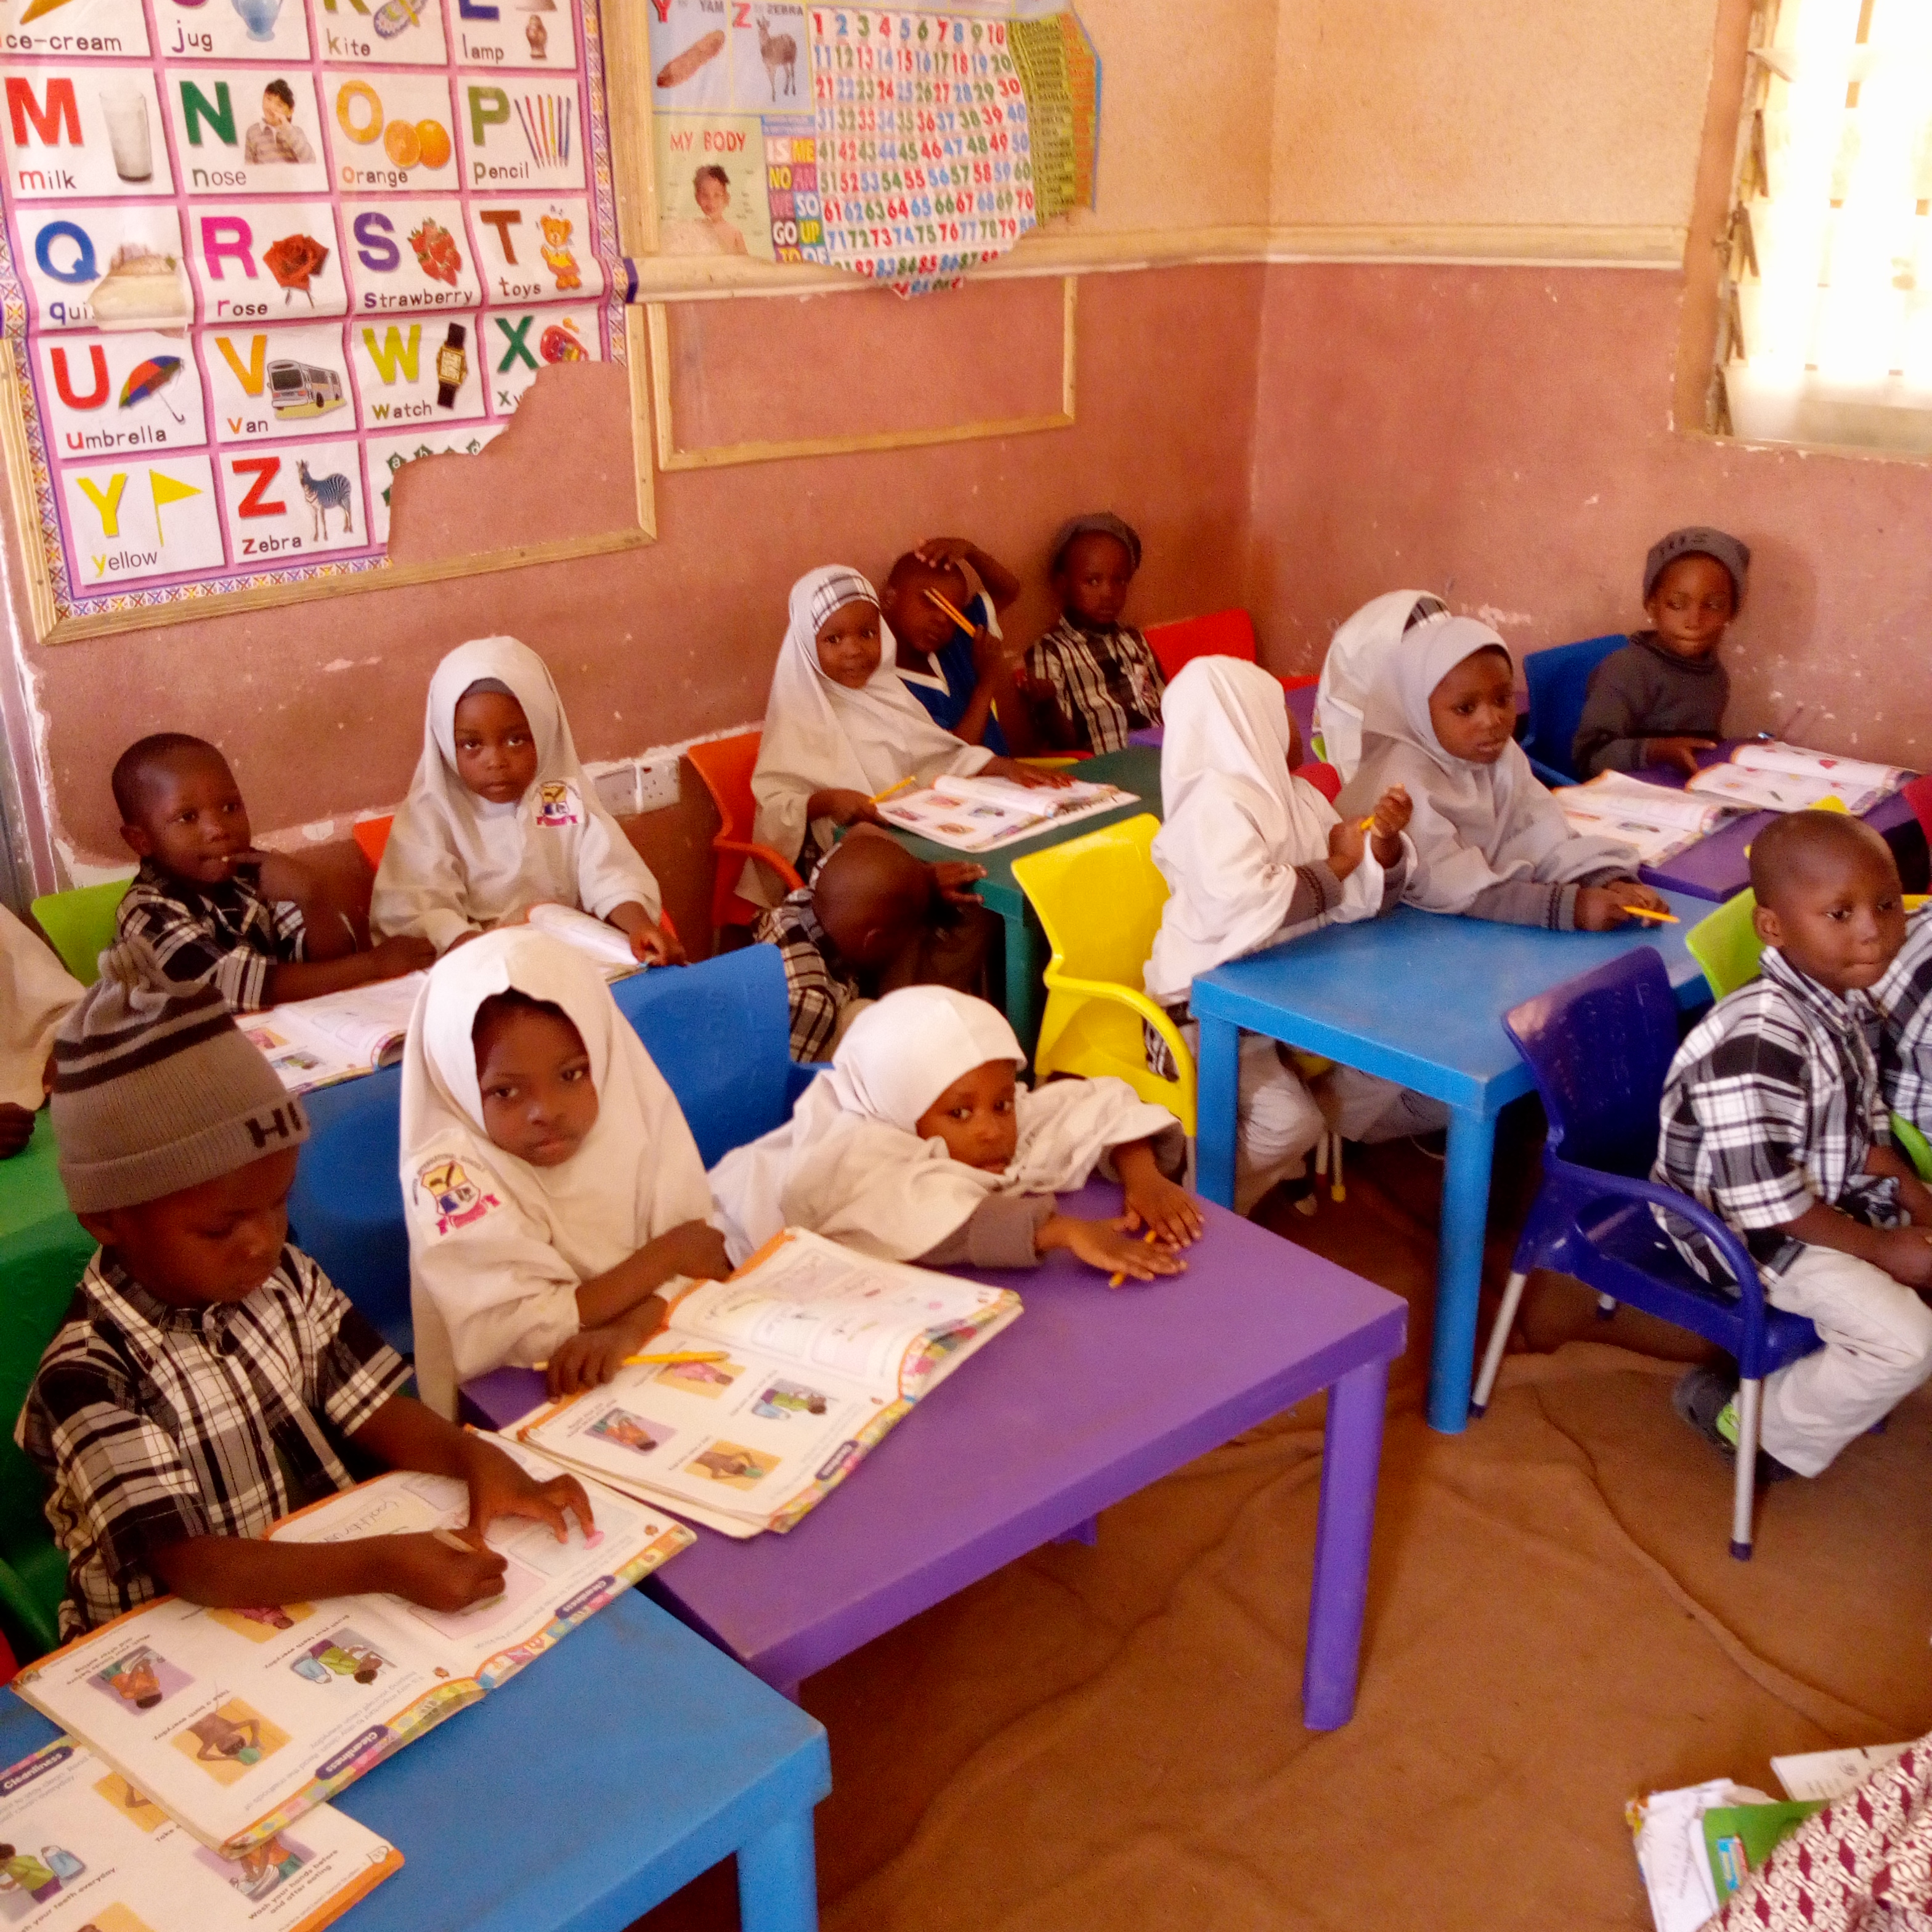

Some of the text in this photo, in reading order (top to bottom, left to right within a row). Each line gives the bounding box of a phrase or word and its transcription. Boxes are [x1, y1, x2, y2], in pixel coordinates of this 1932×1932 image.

[733, 2, 752, 28] Z
[813, 12, 822, 35] 1
[835, 14, 848, 36] 2
[858, 14, 870, 37] 3
[879, 16, 891, 38] 4
[917, 20, 928, 41] 6
[938, 18, 948, 43] 7
[971, 22, 983, 44] 9
[988, 24, 1004, 45] 10
[171, 20, 213, 53] jug
[326, 28, 371, 56] kite
[462, 34, 504, 63] lamp
[815, 45, 831, 68] 11
[835, 45, 853, 69] 12
[858, 46, 873, 70] 13
[897, 49, 912, 73] 15
[934, 51, 949, 74] 17
[953, 52, 968, 75] 18
[991, 54, 1012, 74] 20
[816, 76, 833, 100] 21
[878, 79, 893, 100] 24
[934, 81, 949, 103] 27
[973, 81, 994, 101] 29
[998, 78, 1021, 97] 30
[5, 77, 84, 146] M
[179, 80, 238, 145] N
[336, 80, 384, 145] O
[468, 86, 511, 147] P
[838, 108, 855, 131] 32
[859, 108, 875, 131] 33
[918, 110, 935, 132] 36
[938, 112, 954, 131] 37
[981, 105, 1003, 126] 39
[1008, 103, 1026, 123] 40
[670, 130, 747, 152] MY BODY
[819, 140, 835, 161] 41
[839, 140, 856, 161] 42
[899, 142, 918, 161] 45
[921, 141, 943, 160] 46
[944, 138, 962, 156] 47
[968, 136, 988, 154] 48
[990, 132, 1008, 152] 49
[18, 169, 77, 190] milk
[192, 168, 246, 187] nose
[474, 162, 530, 184] pencil
[770, 166, 792, 190] NO
[821, 172, 837, 193] 51
[841, 172, 859, 193] 52
[861, 172, 879, 192] 53
[882, 172, 902, 192] 54
[904, 169, 925, 189] 55
[928, 169, 949, 187] 56
[951, 164, 968, 185] 57
[973, 161, 992, 183] 58
[797, 193, 820, 216] SO
[824, 198, 842, 222] 61
[845, 202, 863, 221] 62
[866, 201, 885, 220] 63
[888, 197, 909, 219] 64
[912, 197, 931, 216] 65
[935, 196, 954, 214] 66
[956, 192, 973, 213] 67
[1017, 189, 1033, 210] 70
[201, 216, 258, 279] R
[353, 212, 400, 272] S
[480, 210, 523, 266] T
[773, 221, 797, 245] GO
[800, 221, 821, 243] UP
[827, 230, 846, 249] 71
[848, 230, 870, 248] 72
[870, 228, 892, 248] 73
[894, 227, 914, 244] 74
[915, 224, 936, 243] 75
[939, 222, 959, 241] 76
[960, 221, 976, 240] 77
[35, 221, 101, 284] Q
[499, 277, 542, 297] toys
[50, 301, 94, 325] qui
[217, 299, 267, 317] rose
[362, 323, 421, 385] W
[495, 315, 540, 372] X
[50, 344, 110, 410] U
[215, 334, 267, 396] V
[232, 457, 287, 519] Z
[76, 473, 128, 538] Y
[91, 551, 158, 578] yellow
[323, 1729, 380, 1774] Cleanliness
[2, 1750, 64, 1791] Cleanliness
[247, 1848, 339, 1921] Wash your hands before
[268, 1899, 286, 1915] and
[284, 1883, 306, 1902] after
